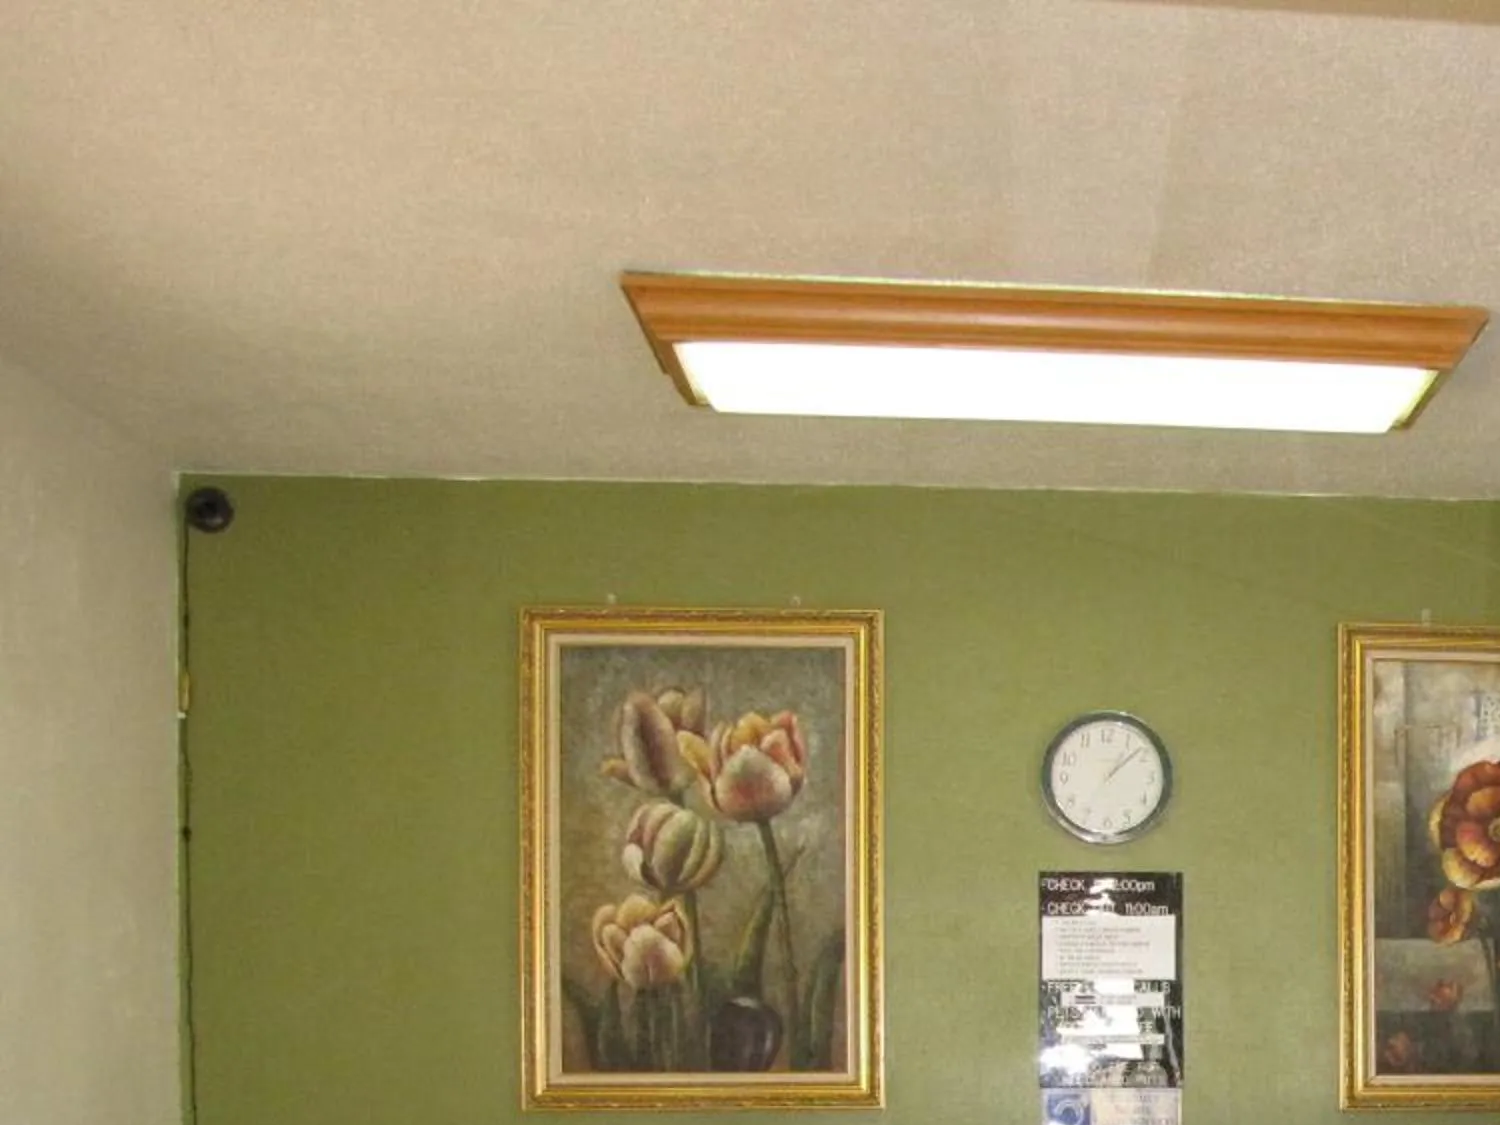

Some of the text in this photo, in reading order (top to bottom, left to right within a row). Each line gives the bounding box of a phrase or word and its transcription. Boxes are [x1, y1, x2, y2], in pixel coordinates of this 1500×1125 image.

[1080, 732, 1091, 748] 11
[1101, 729, 1115, 744] 12
[1062, 751, 1076, 767] 10
[1059, 773, 1069, 785] 9
[1047, 877, 1086, 891] CHECK
[1047, 902, 1086, 915] CHECK
[1152, 1007, 1182, 1019] WITH
